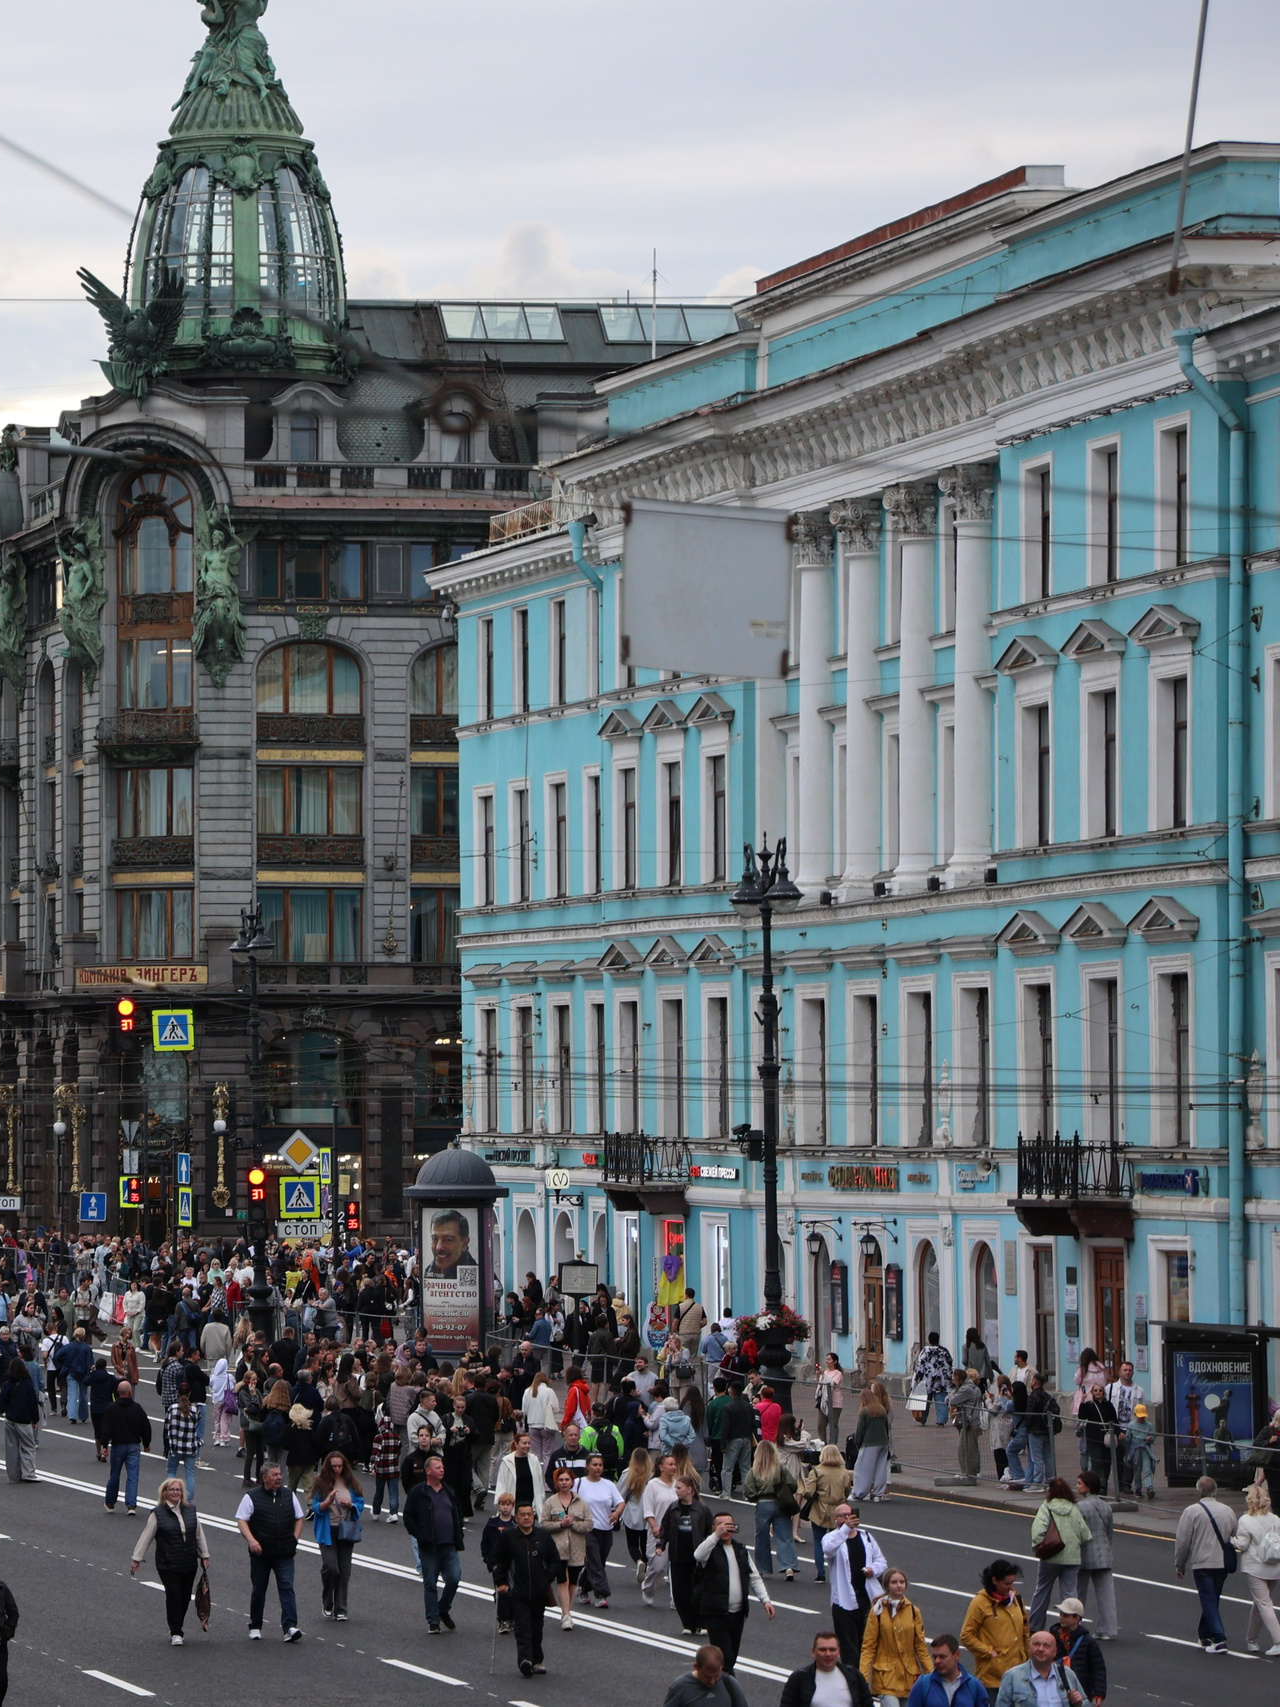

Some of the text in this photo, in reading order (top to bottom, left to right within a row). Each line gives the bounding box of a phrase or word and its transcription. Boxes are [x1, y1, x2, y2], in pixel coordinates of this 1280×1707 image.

[121, 1019, 133, 1031] 37
[251, 1188, 264, 1201] 37
[284, 1224, 318, 1236] СТОП
[347, 1218, 359, 1230] 35
[424, 1280, 458, 1291] Брачное
[430, 1290, 478, 1298] агентство
[429, 1310, 458, 1318] Невский
[431, 1323, 468, 1331] 940-92-07
[1188, 1361, 1251, 1373] ВДОХНОВЕНИЕ
